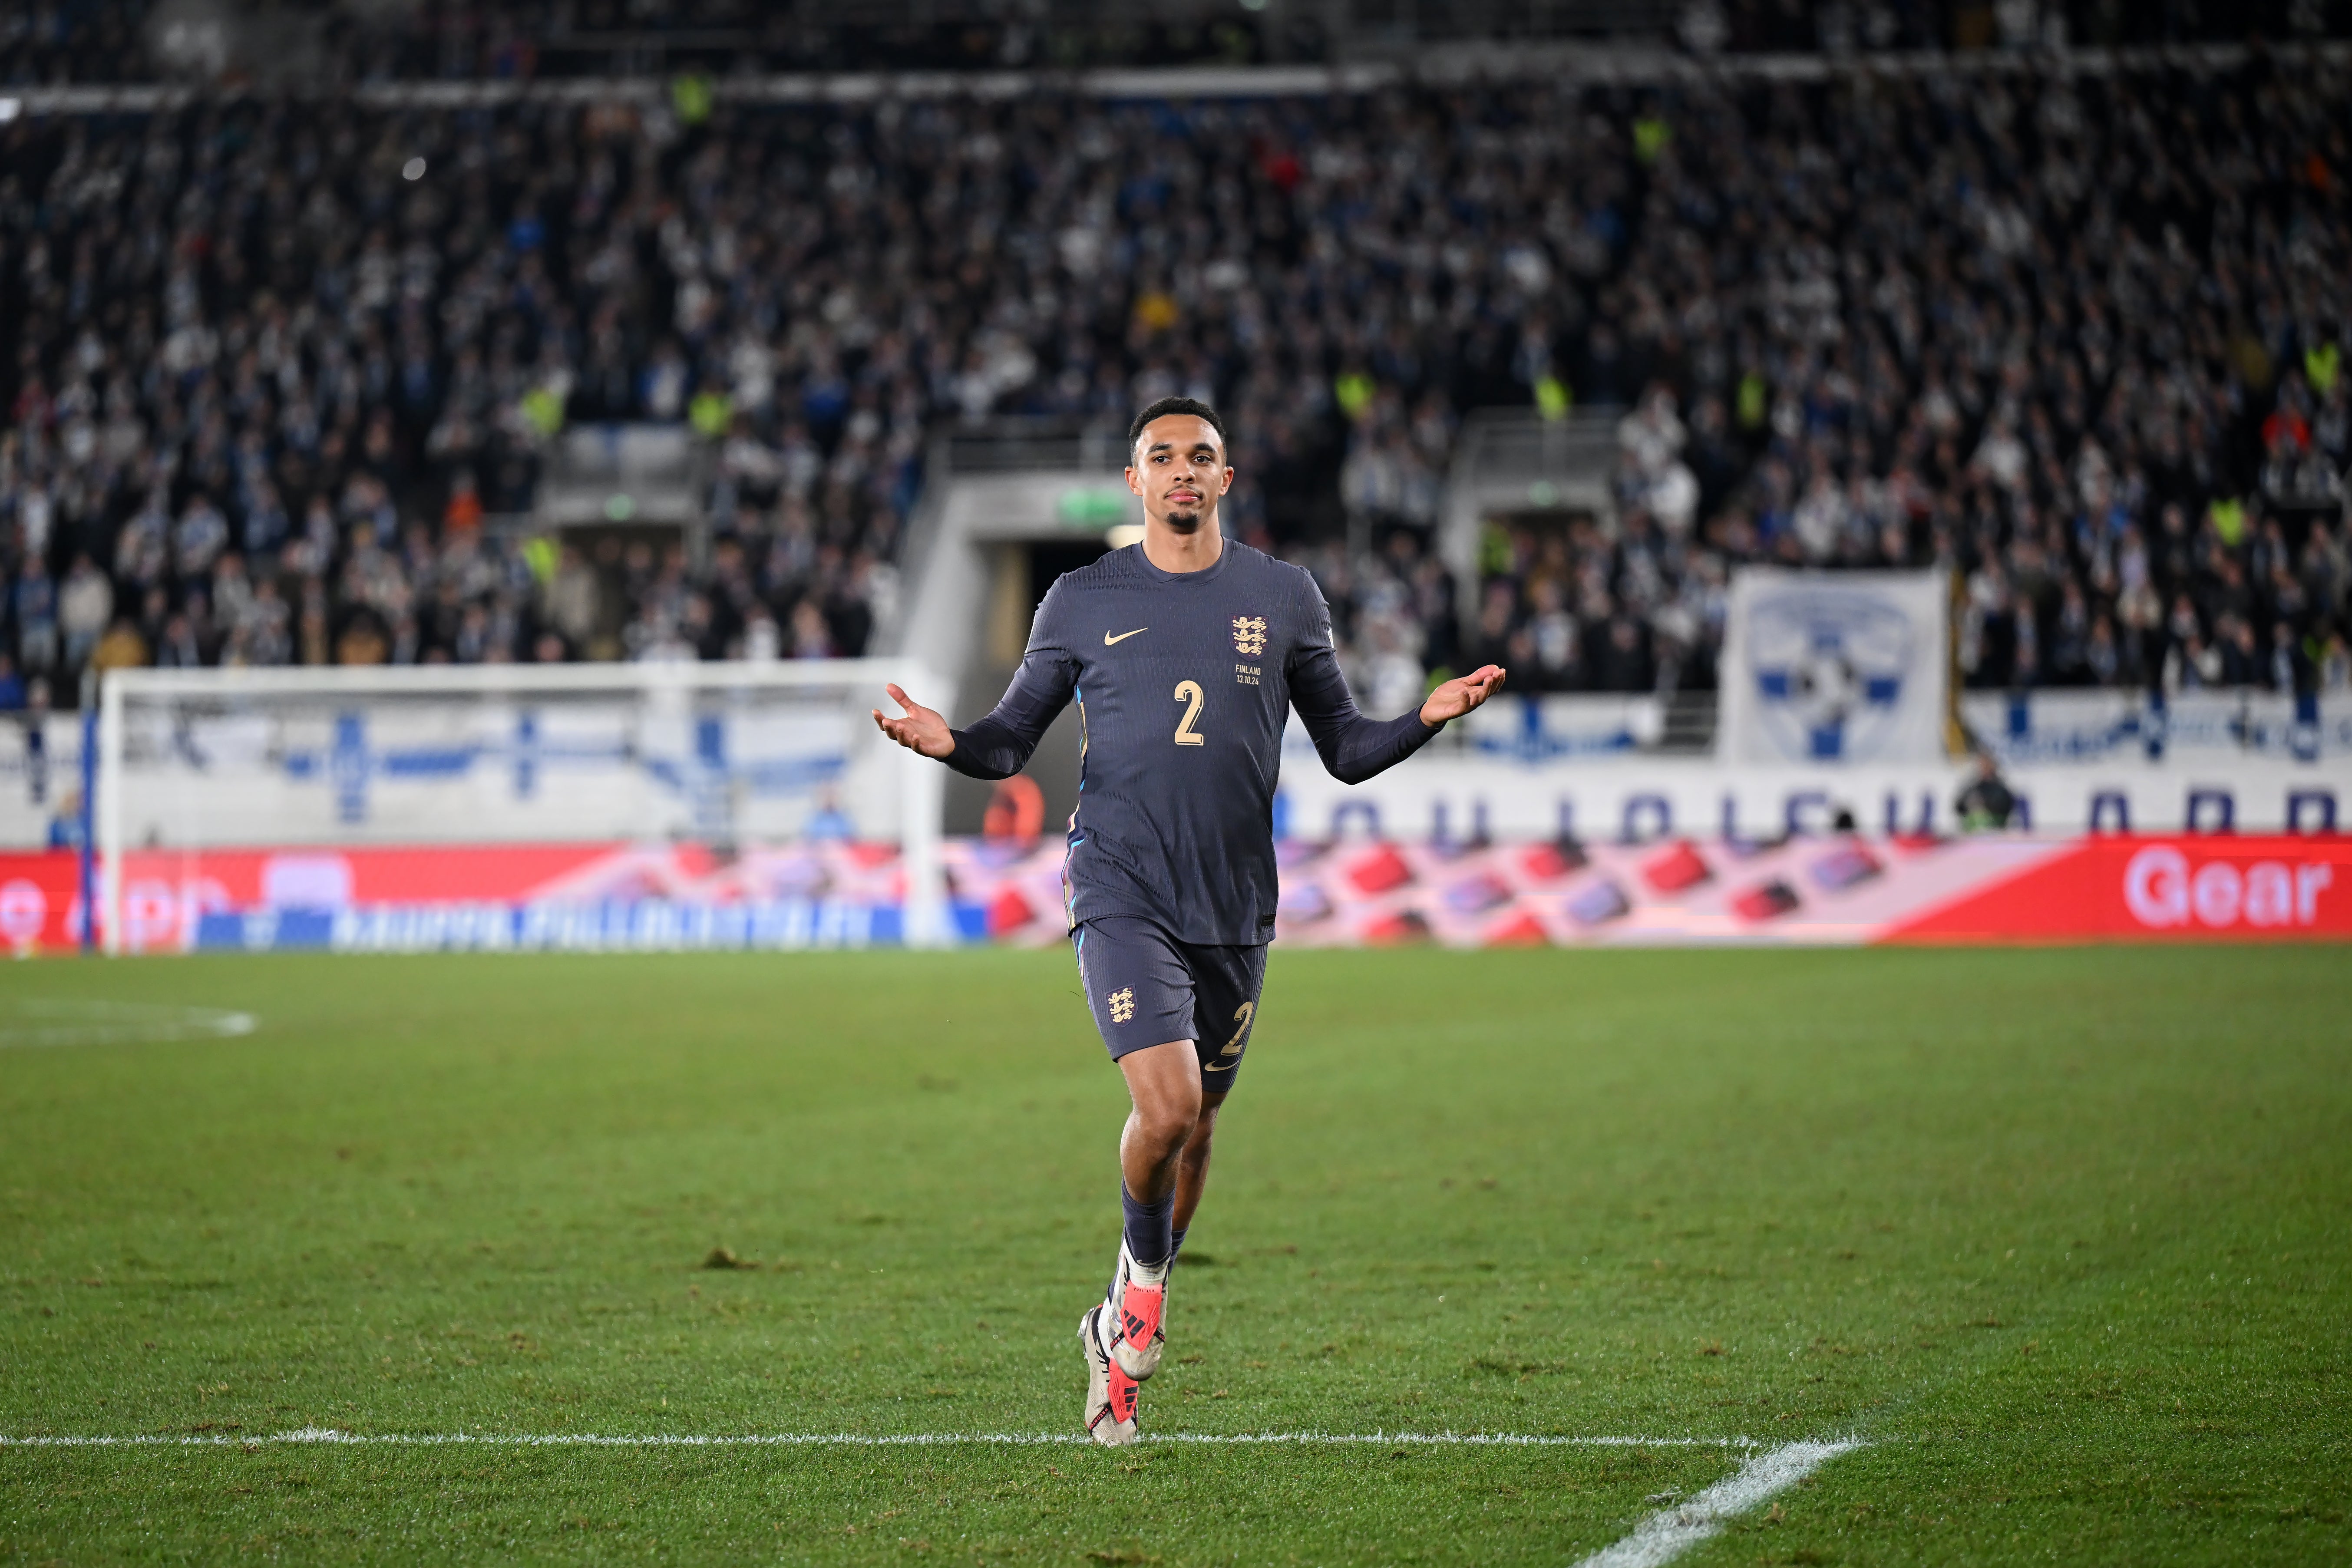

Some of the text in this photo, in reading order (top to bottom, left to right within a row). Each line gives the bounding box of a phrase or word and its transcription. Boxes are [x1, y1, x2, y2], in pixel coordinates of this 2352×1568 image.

[1235, 664, 1261, 675] FINLAND
[1236, 674, 1259, 685] 13.10.24
[1174, 680, 1204, 746] 2
[2123, 843, 2334, 928] Gear
[1220, 1001, 1253, 1056] 2
[1089, 1407, 1108, 1430] PREDATOR
